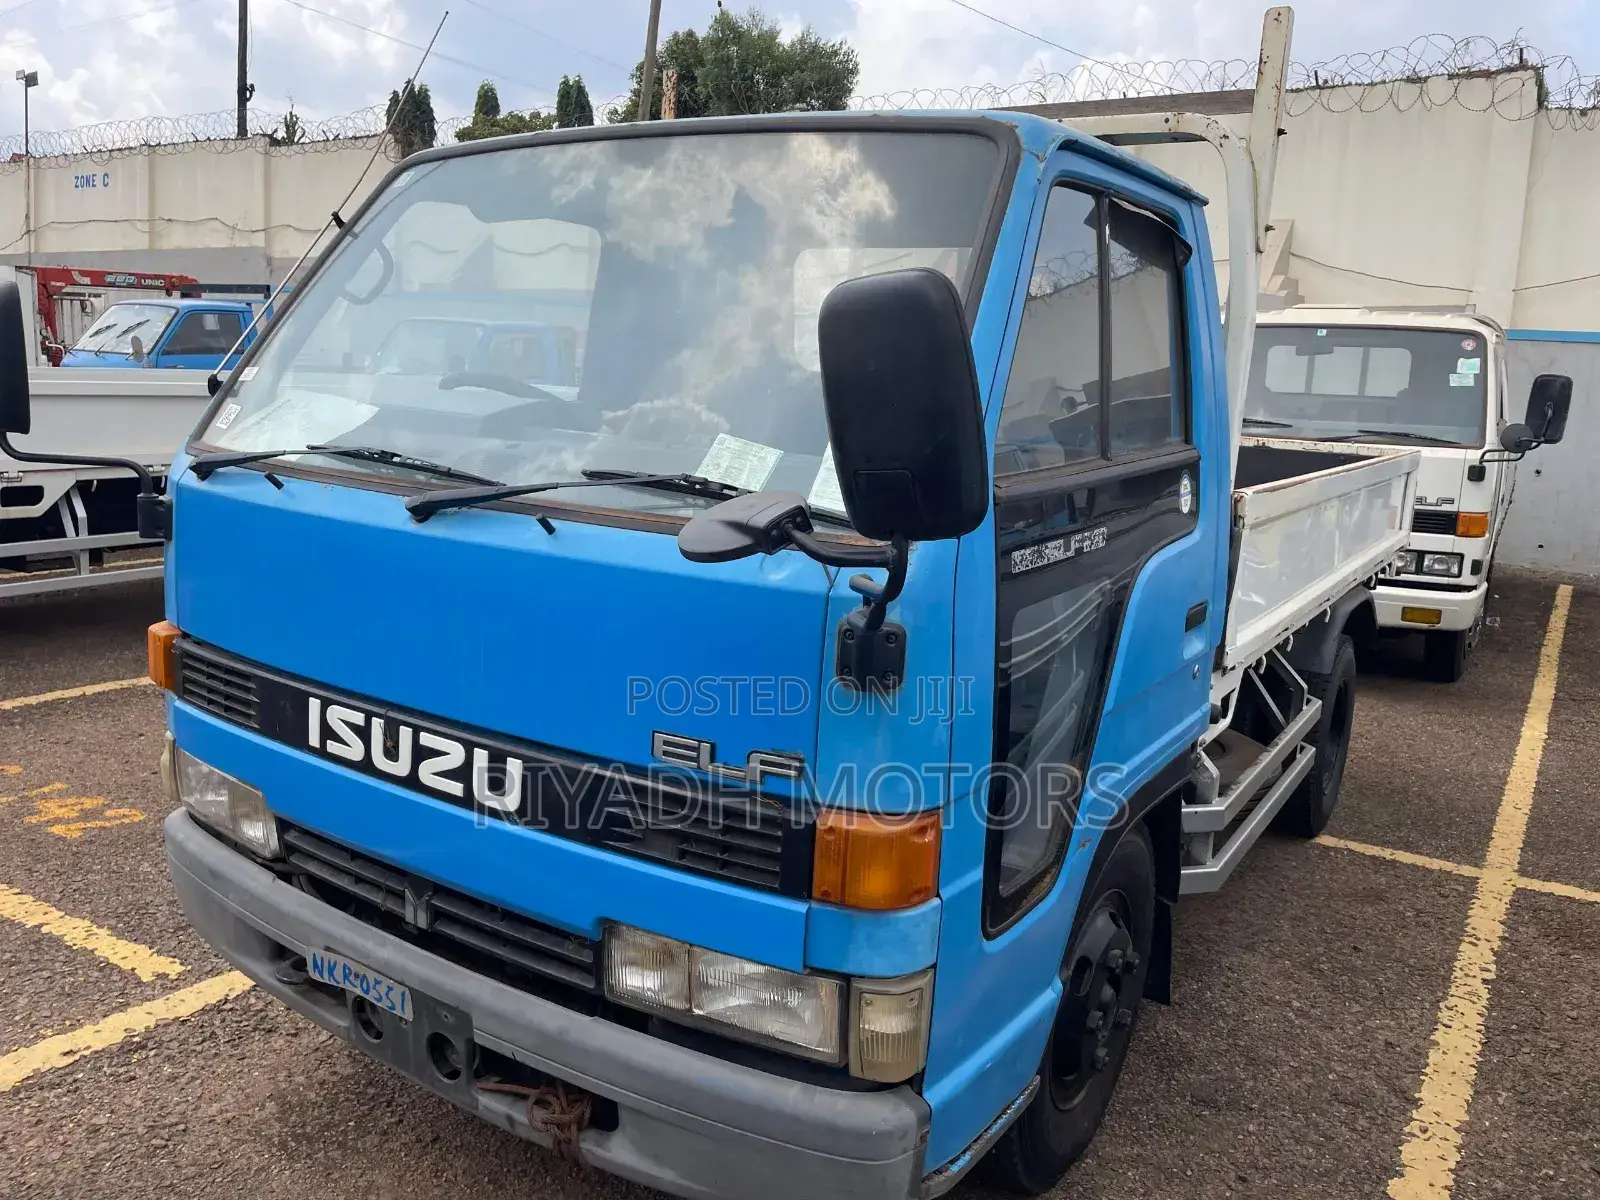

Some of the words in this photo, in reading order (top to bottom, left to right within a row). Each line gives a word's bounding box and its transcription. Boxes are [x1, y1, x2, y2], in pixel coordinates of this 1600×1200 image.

[74, 173, 97, 188] ZONE
[102, 172, 110, 187] C
[141, 278, 165, 287] UNIC
[308, 696, 523, 812] ISUZU
[651, 730, 805, 785] ELF
